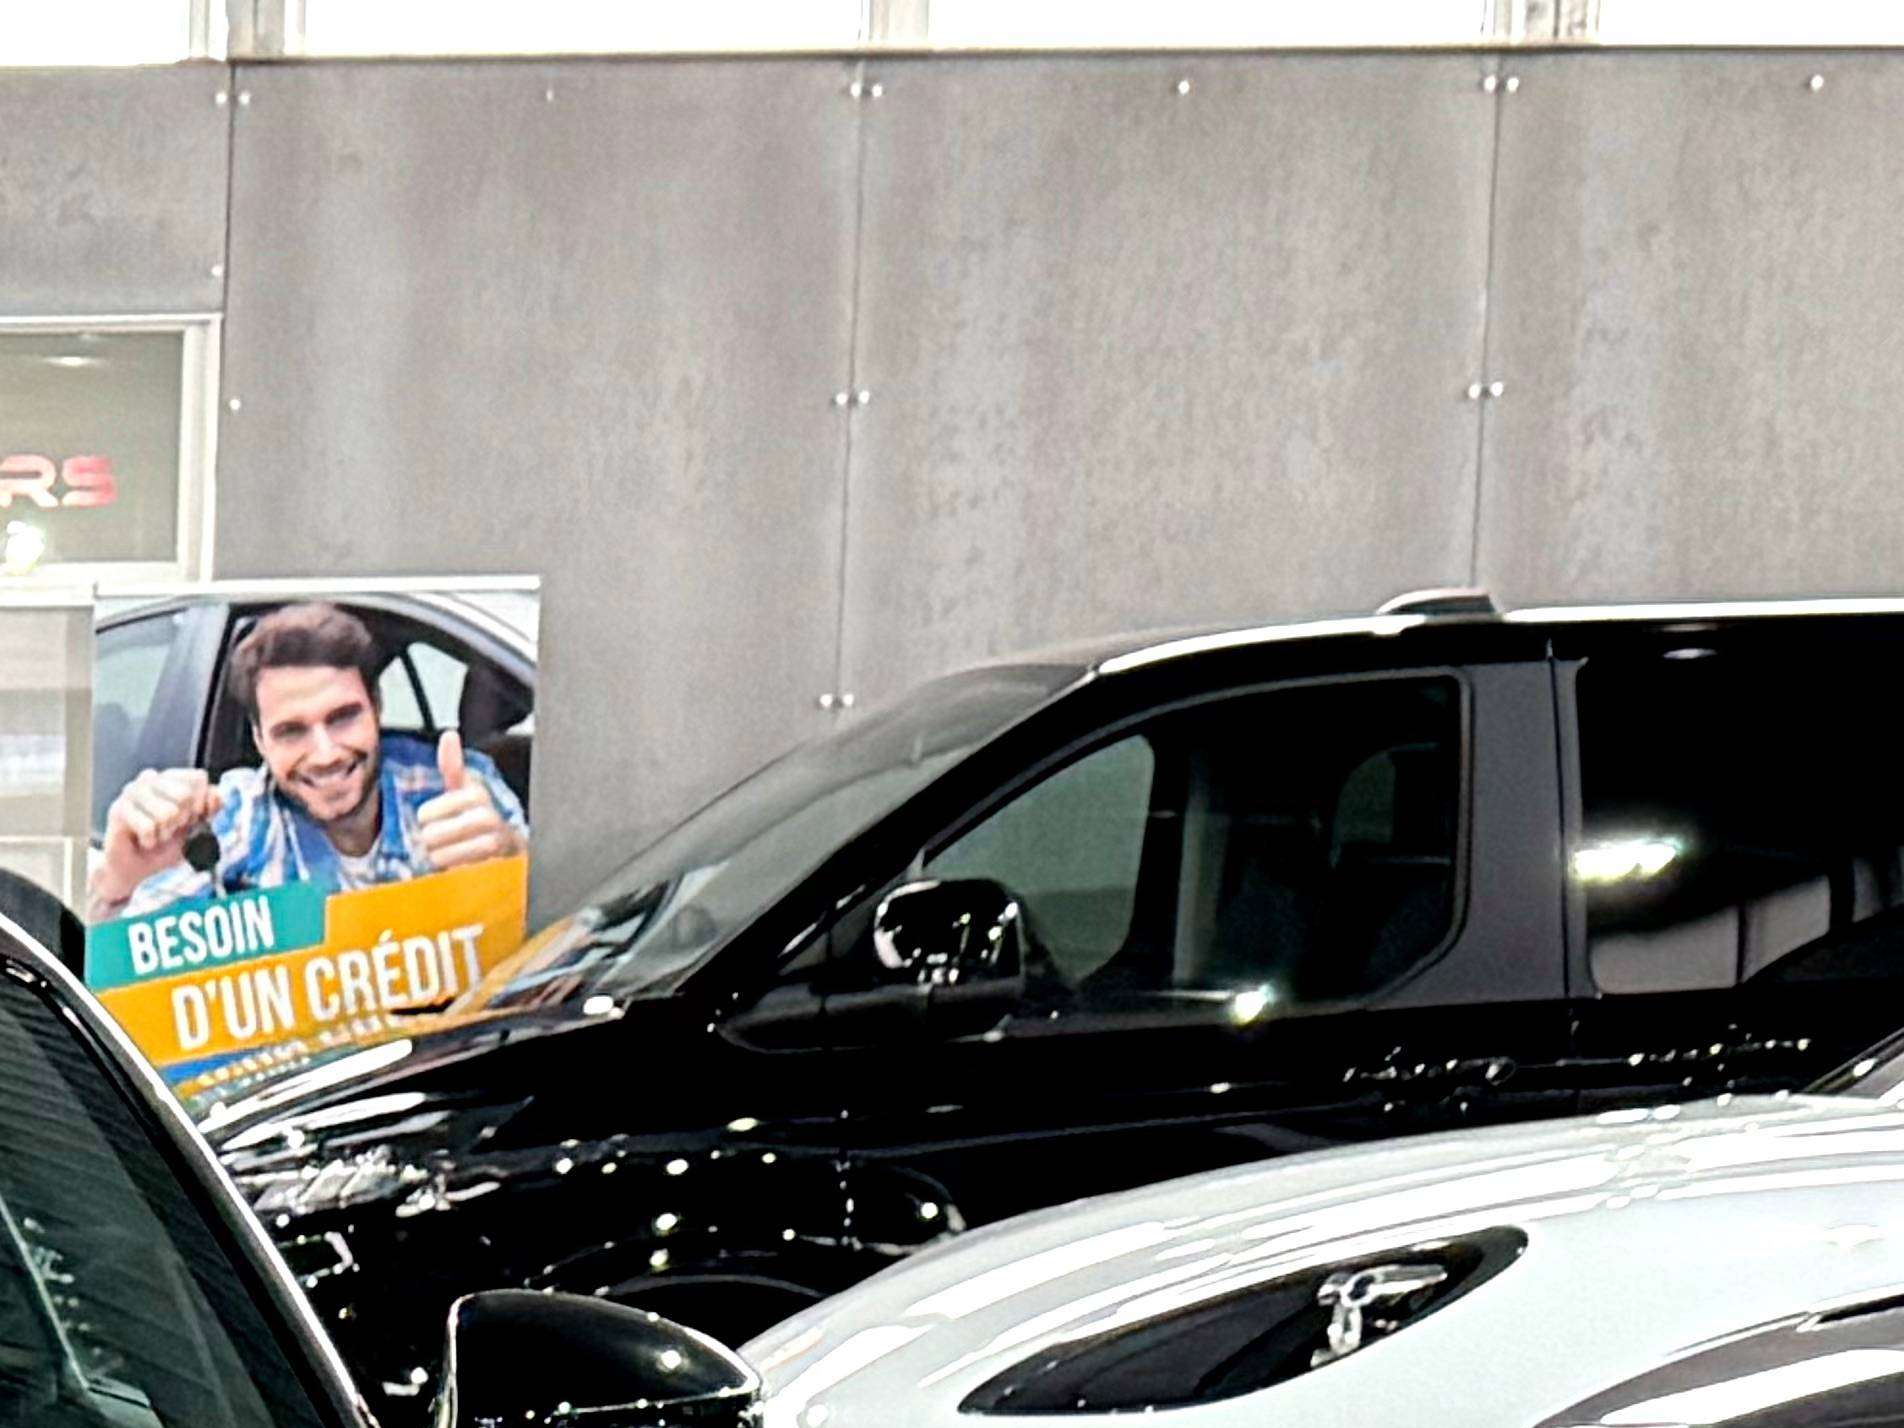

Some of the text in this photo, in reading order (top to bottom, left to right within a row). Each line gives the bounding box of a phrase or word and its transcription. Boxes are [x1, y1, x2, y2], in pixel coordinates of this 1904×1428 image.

[128, 896, 275, 976] BESOIN
[171, 929, 485, 1052] D'UN CRÉDIT
